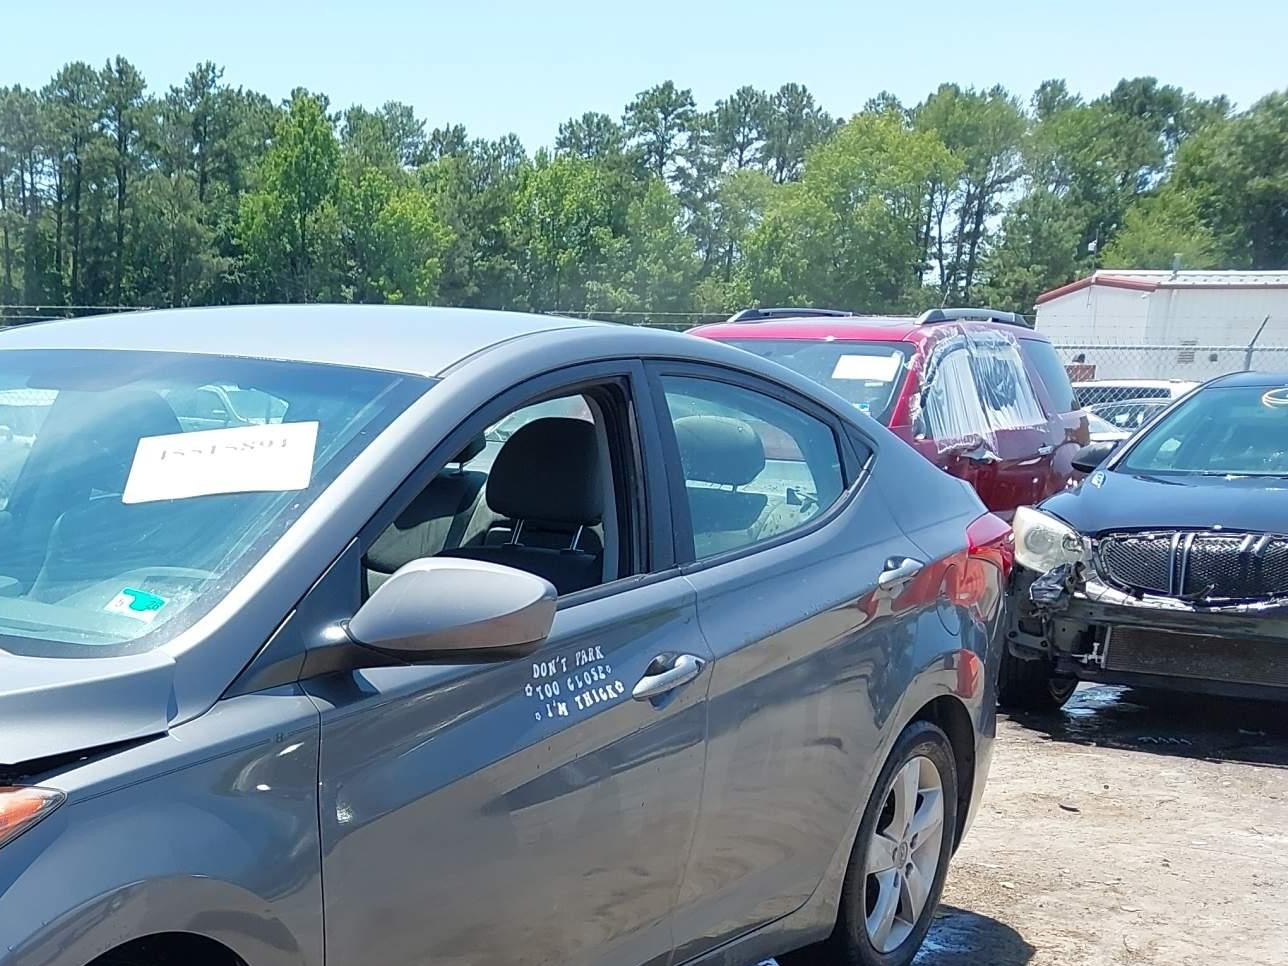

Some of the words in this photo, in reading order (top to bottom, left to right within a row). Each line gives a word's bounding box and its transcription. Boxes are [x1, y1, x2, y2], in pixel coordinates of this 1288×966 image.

[532, 656, 567, 679] DON'T
[575, 645, 605, 666] PARK
[535, 680, 560, 700] TOO
[567, 665, 606, 691] CLOSE
[545, 699, 569, 718] I'M
[574, 684, 618, 710] THICK
